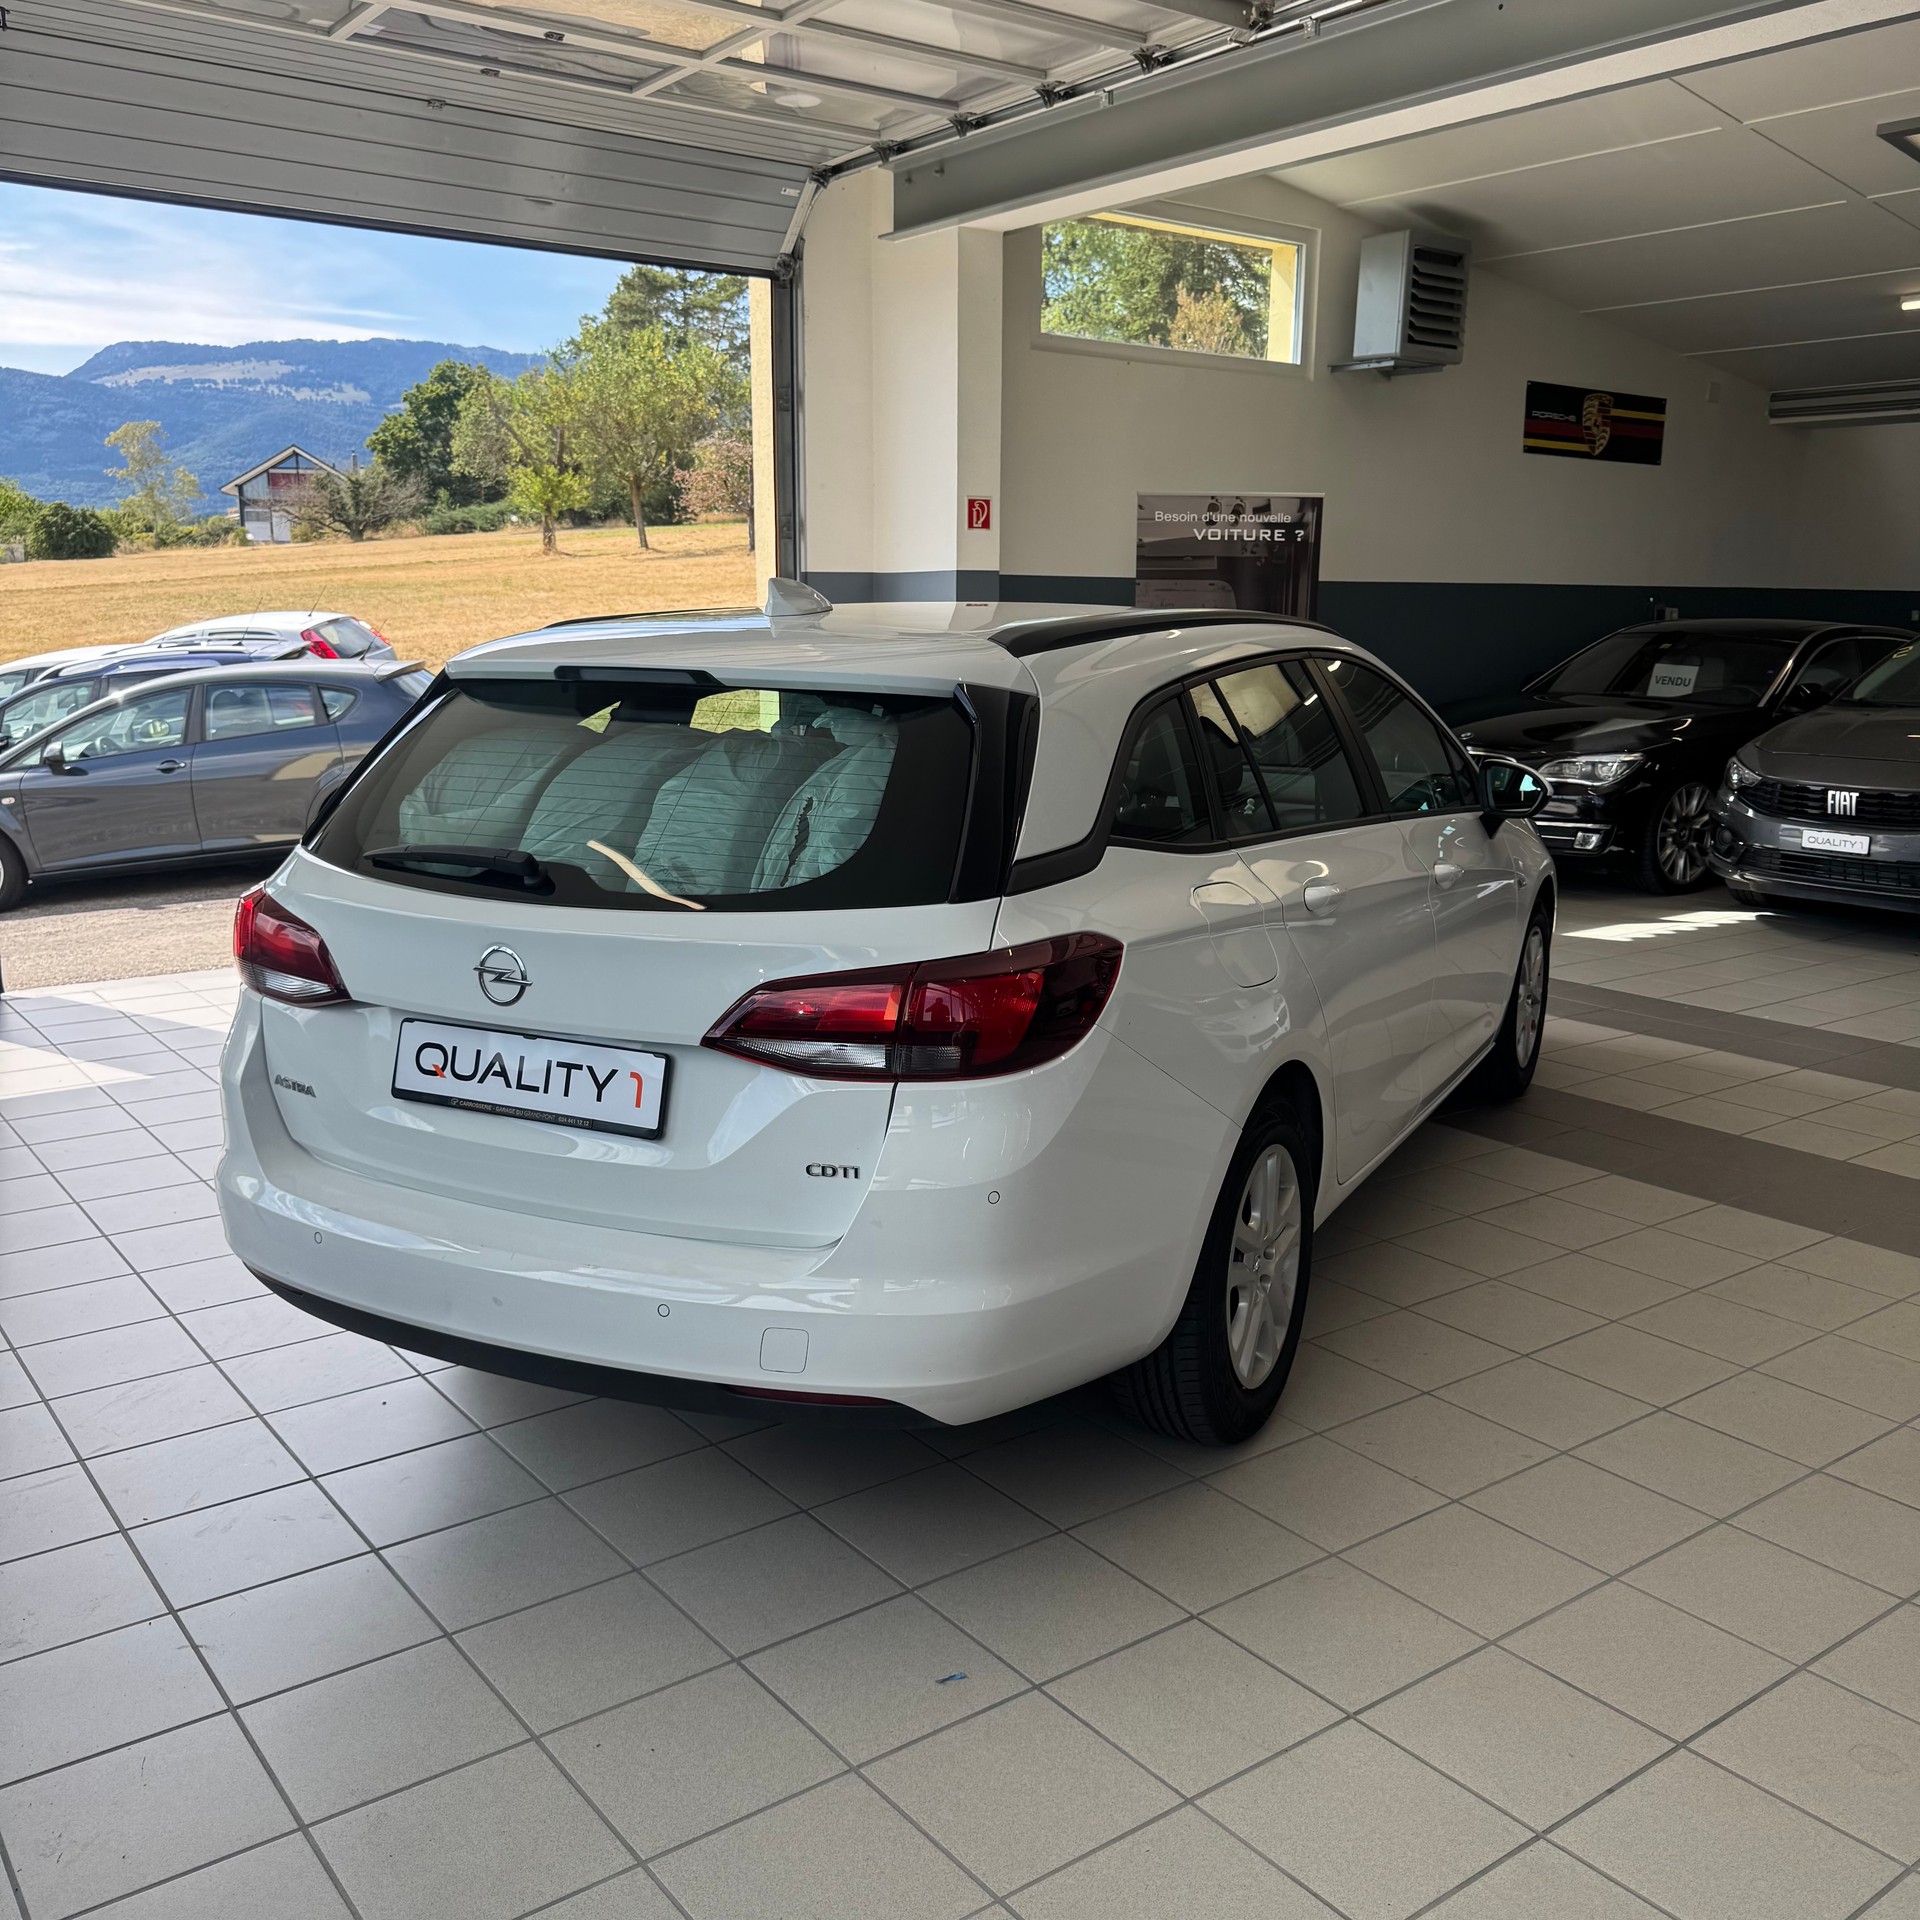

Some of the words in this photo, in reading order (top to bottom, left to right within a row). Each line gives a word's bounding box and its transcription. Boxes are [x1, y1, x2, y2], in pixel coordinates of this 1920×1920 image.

[1532, 410, 1577, 422] PORSCHE
[1154, 511, 1198, 523] Besoin
[1201, 511, 1236, 523] d'une
[1239, 512, 1292, 524] nouvelle
[1193, 528, 1286, 542] VOITURE
[1294, 529, 1305, 542] ?
[1655, 675, 1692, 688] VENDU
[1827, 789, 1860, 817] FIAT
[1807, 835, 1858, 849] QUALITY
[414, 1041, 619, 1103] QUALITY
[629, 1070, 644, 1109] 1
[274, 1073, 317, 1098] ASTRA
[459, 1100, 492, 1111] CARROSSERIE
[495, 1106, 516, 1115] GARAGE
[516, 1108, 524, 1116] DU
[805, 1162, 861, 1179] CDTI
